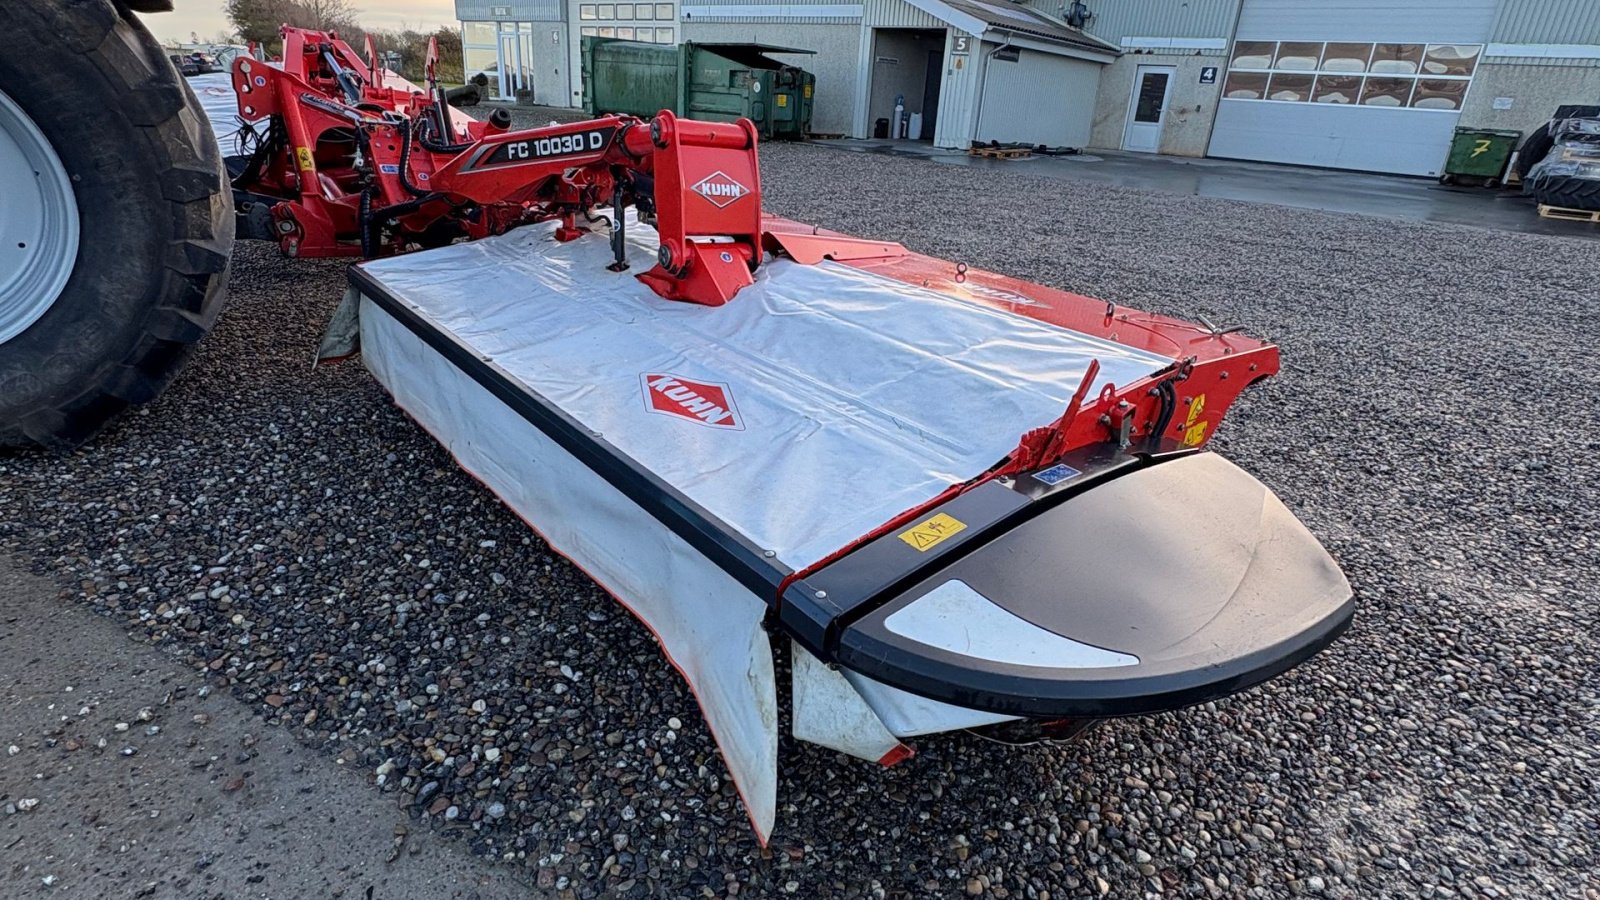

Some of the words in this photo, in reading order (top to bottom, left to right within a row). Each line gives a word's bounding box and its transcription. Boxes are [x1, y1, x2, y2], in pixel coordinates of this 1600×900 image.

[957, 37, 966, 50] 5
[1203, 68, 1214, 80] 4
[507, 142, 529, 160] FC
[533, 134, 584, 156] 10030
[589, 132, 603, 150] D
[1470, 139, 1492, 158] 7
[701, 182, 740, 197] KUHN
[647, 376, 733, 424] KUHN
